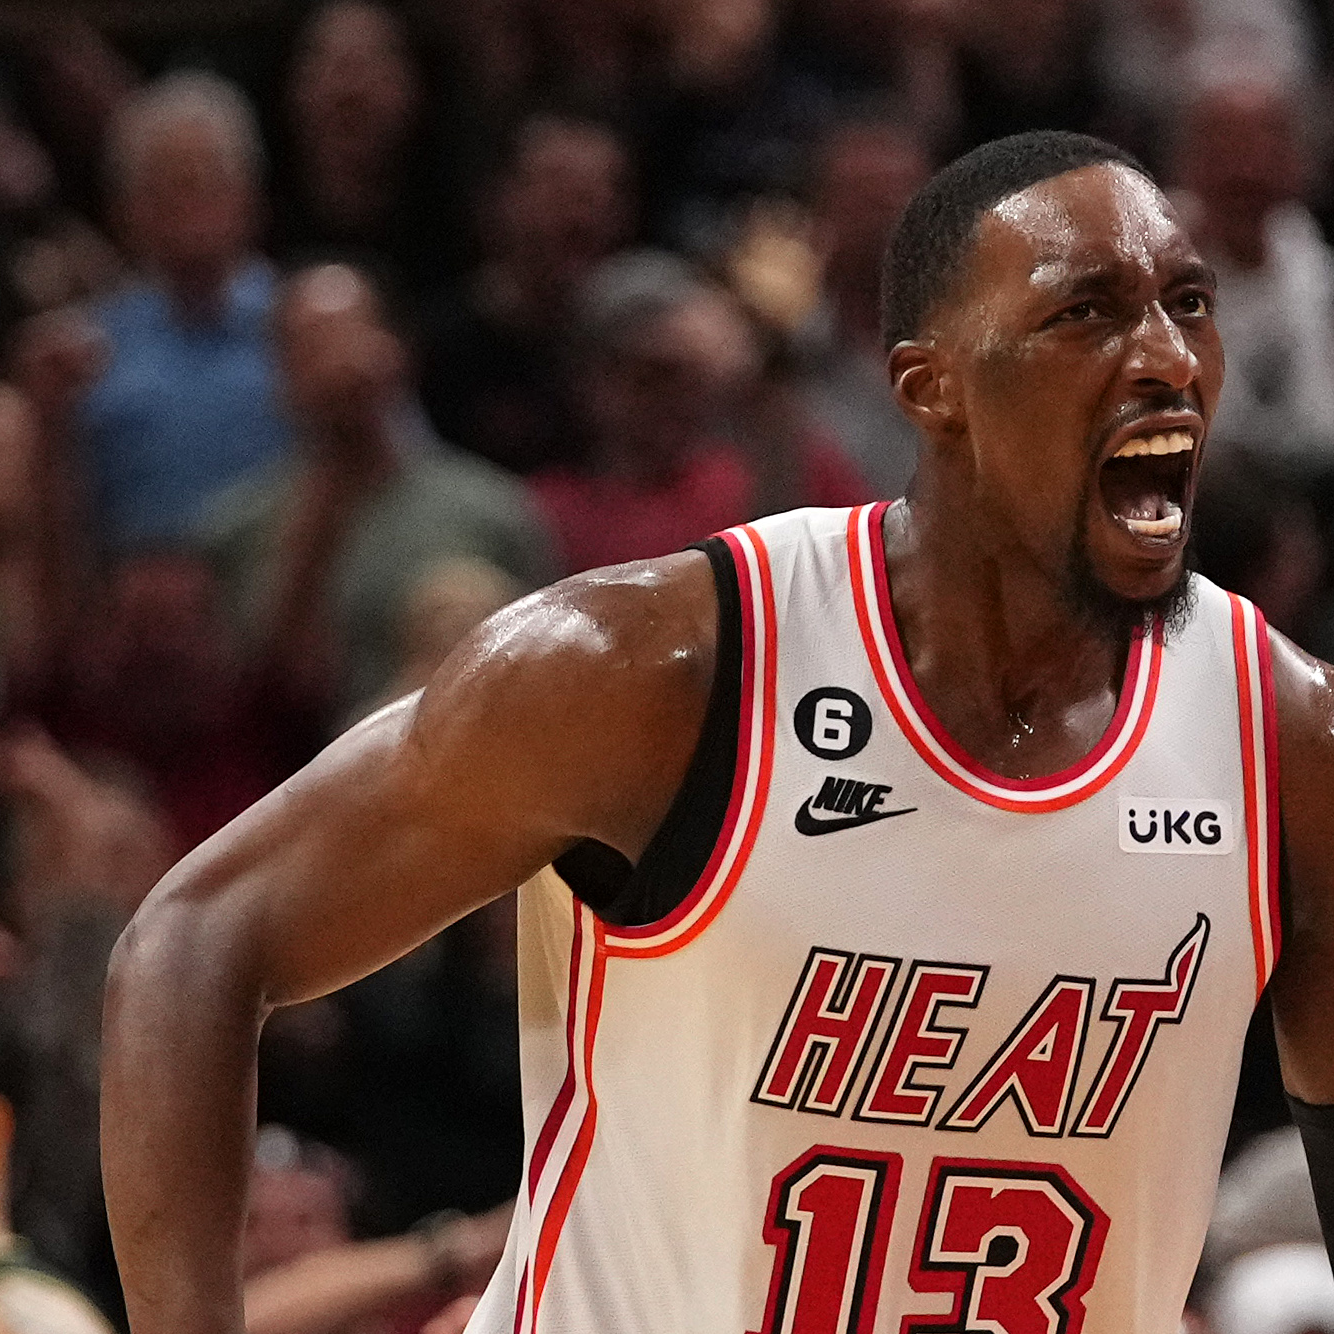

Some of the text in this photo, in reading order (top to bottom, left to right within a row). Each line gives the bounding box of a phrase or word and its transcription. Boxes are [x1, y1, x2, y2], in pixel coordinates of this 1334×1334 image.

[812, 697, 853, 751] 6
[812, 776, 893, 817] NIKE
[750, 912, 1210, 1139] HEAT
